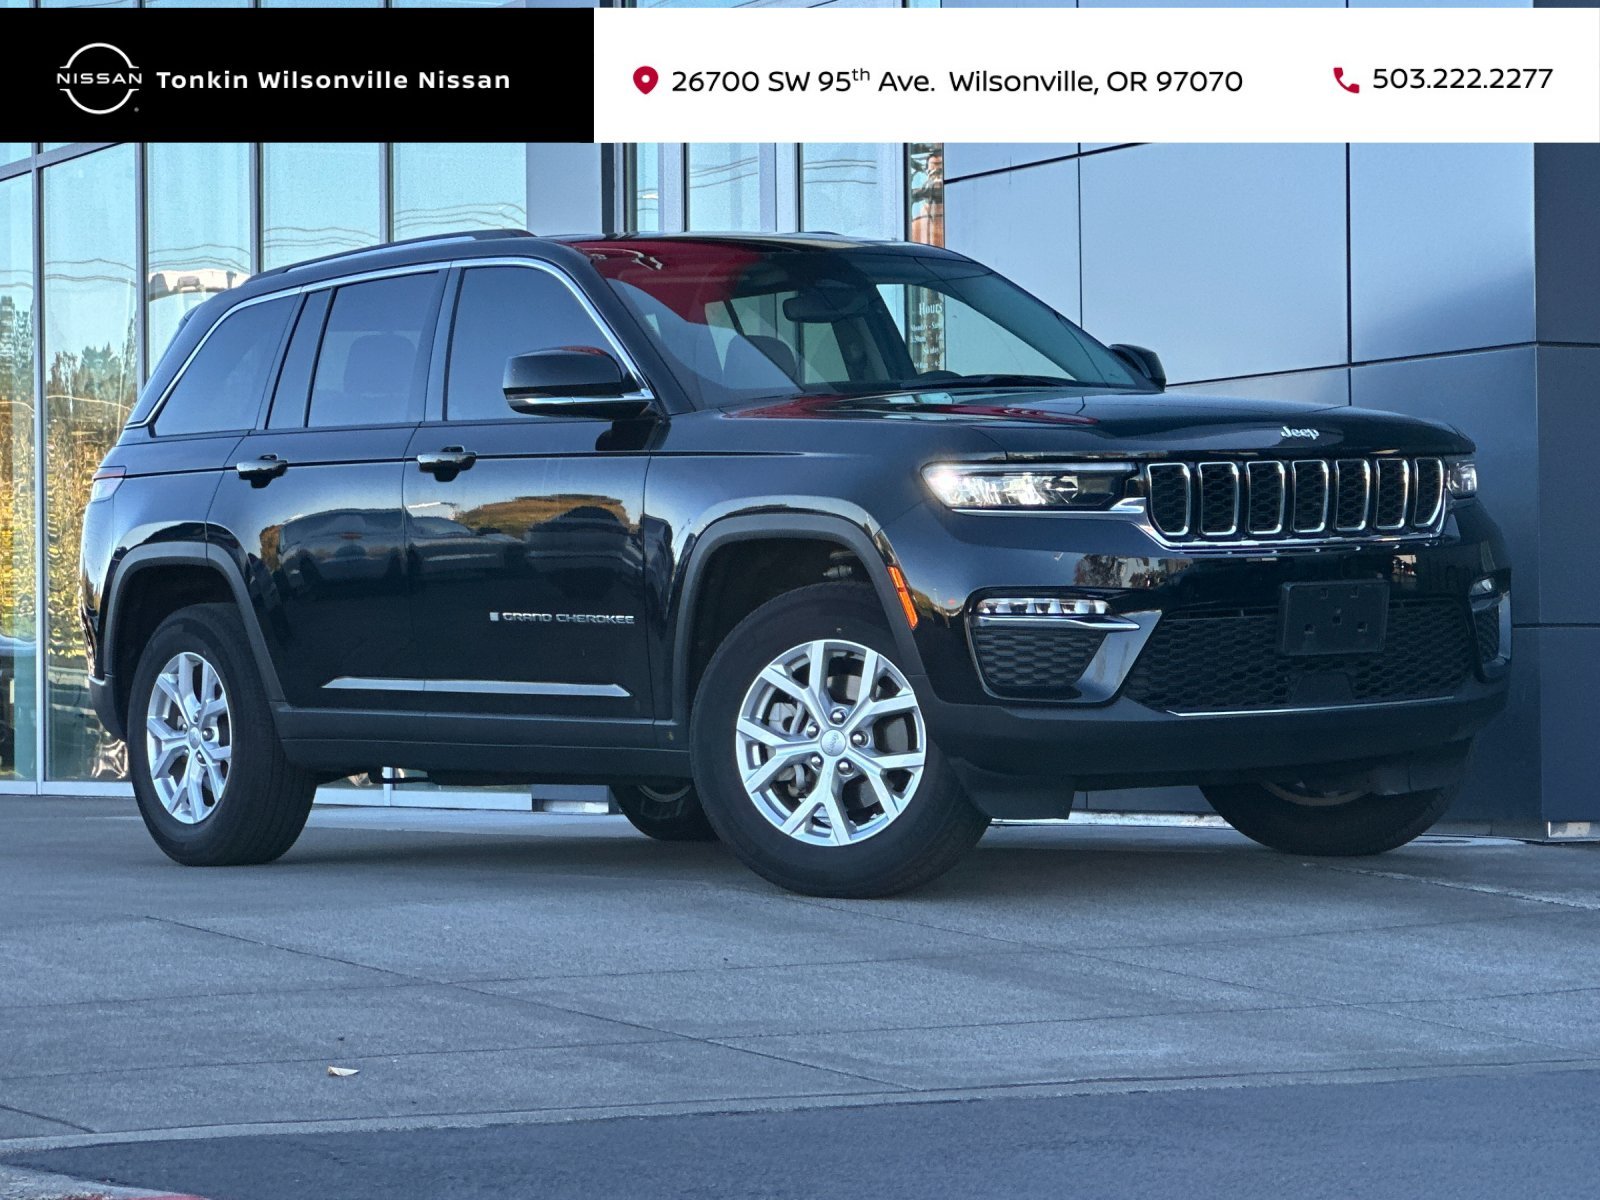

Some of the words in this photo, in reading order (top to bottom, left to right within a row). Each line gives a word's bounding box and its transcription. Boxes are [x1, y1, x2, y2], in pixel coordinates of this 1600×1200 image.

[1280, 425, 1320, 440] Jeep
[502, 612, 553, 622] GRAND
[555, 613, 635, 624] CHEROKEE
